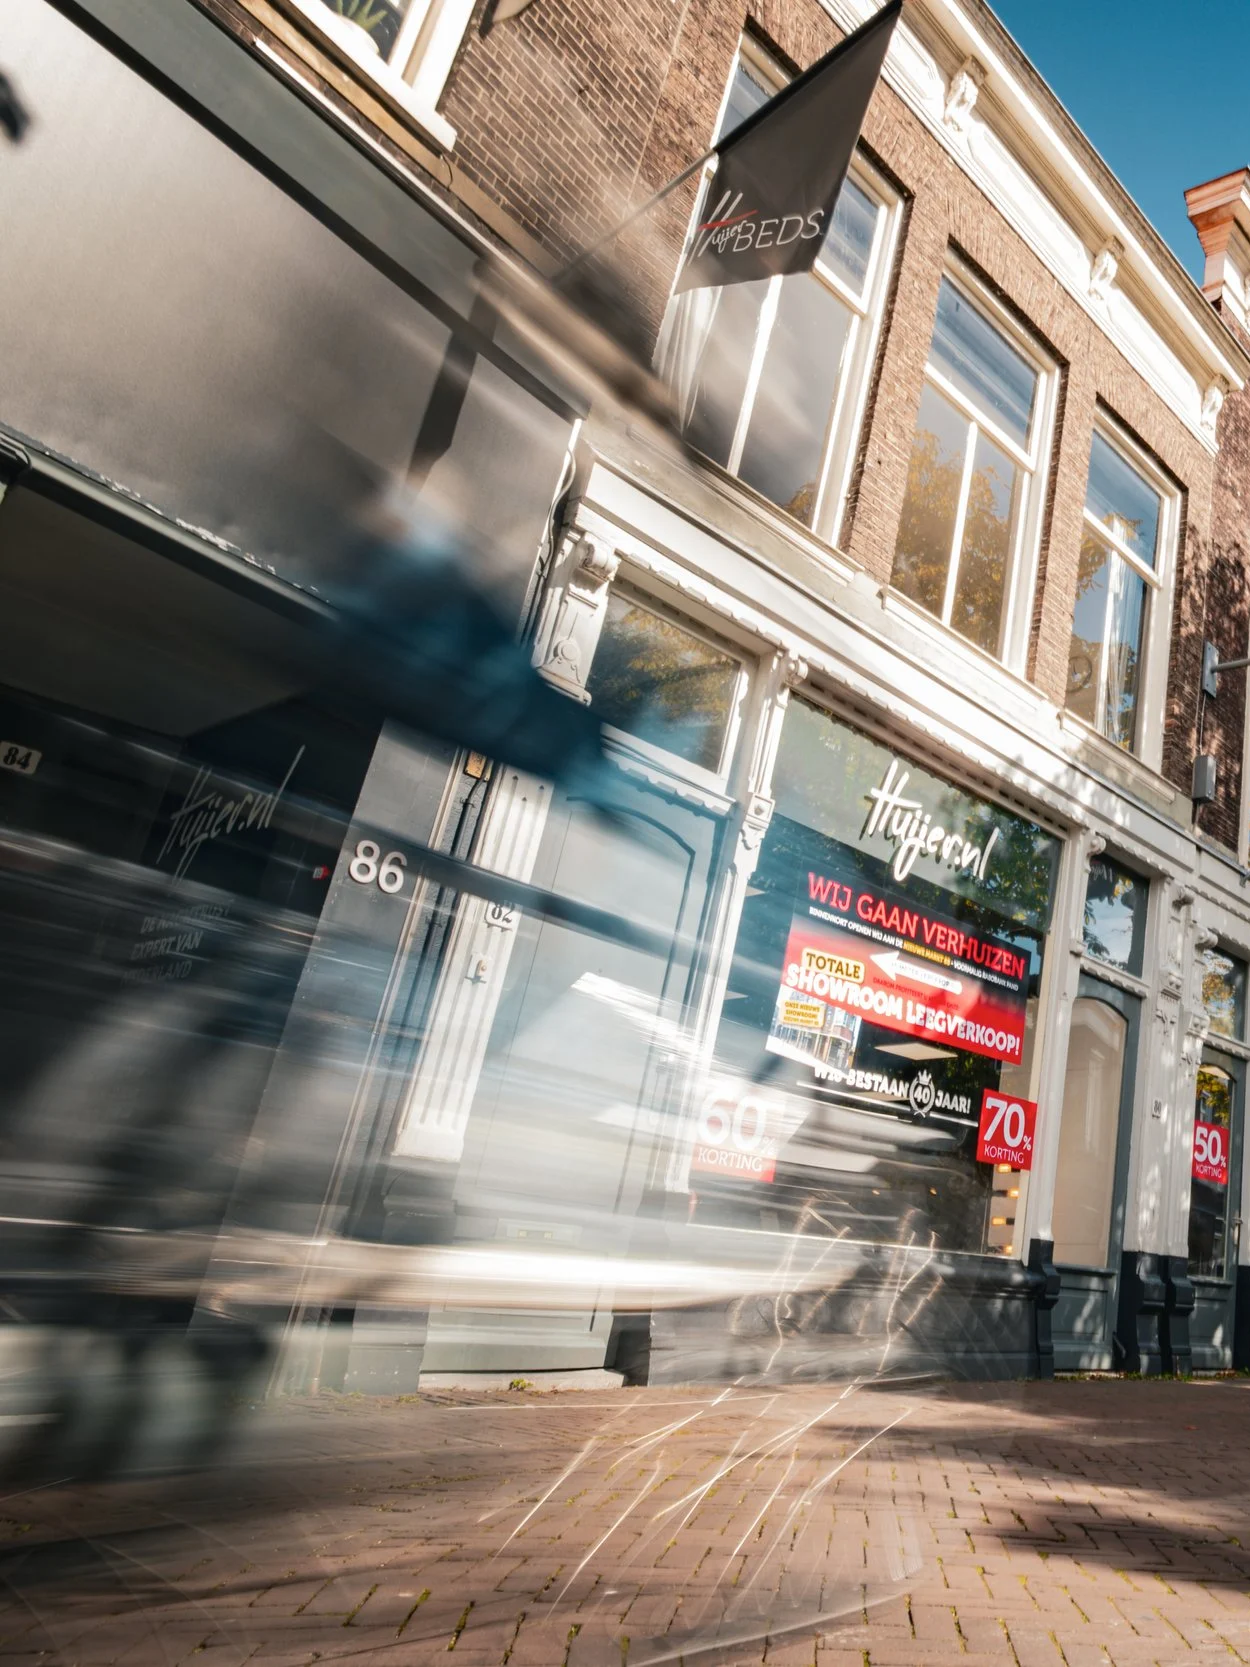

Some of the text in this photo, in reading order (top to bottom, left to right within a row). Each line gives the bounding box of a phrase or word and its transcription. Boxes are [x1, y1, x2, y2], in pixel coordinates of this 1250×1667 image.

[733, 207, 825, 252] BEDS
[3, 746, 32, 770] 84
[349, 839, 408, 894] 86
[175, 930, 204, 953] VAN
[807, 872, 852, 912] WIJ
[856, 894, 918, 939] GAAN
[921, 916, 1026, 980] VERHUIZEN
[806, 953, 861, 979] TOTALE
[785, 963, 903, 1020] SHOWROOM
[906, 1001, 1021, 1055] LEEGVERKOOP!
[846, 1069, 910, 1099] BESTAAN
[914, 1086, 930, 1104] 40
[935, 1090, 971, 1114] JAAR!
[984, 1096, 1032, 1152] 70%
[697, 1147, 763, 1173] KORTING
[984, 1144, 1025, 1164] KORTING
[1194, 1126, 1227, 1168] 50%
[1195, 1164, 1222, 1180] KORTING
